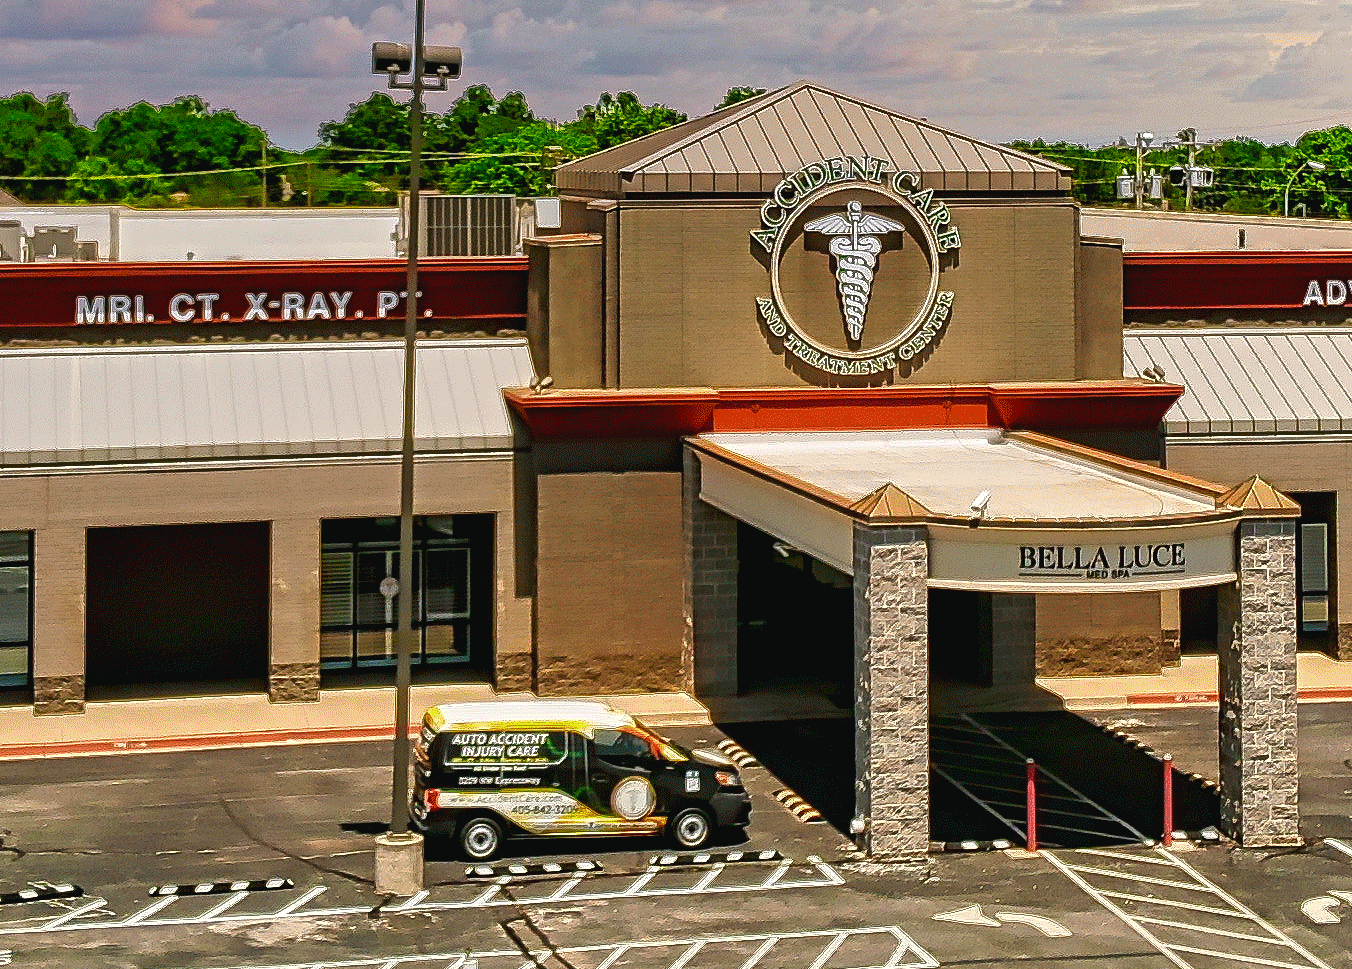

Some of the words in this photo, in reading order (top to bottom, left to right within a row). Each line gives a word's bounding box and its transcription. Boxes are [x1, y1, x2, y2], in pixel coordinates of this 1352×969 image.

[750, 156, 890, 253] ACCIDENT
[892, 171, 961, 253] CARE
[75, 295, 155, 325] MRI.
[168, 293, 231, 324] CT.
[243, 291, 365, 322] X-RAY.
[755, 296, 787, 338] AND
[783, 333, 897, 375] TREATMENT
[898, 291, 956, 360] CENTER
[1019, 545, 1110, 569] BELLA
[1118, 543, 1186, 568] LUCE
[1086, 570, 1109, 579] MED
[452, 733, 487, 745] AUTO
[488, 733, 550, 745] ACCIDENT
[461, 745, 505, 757] INJURY
[507, 745, 540, 757] CARE
